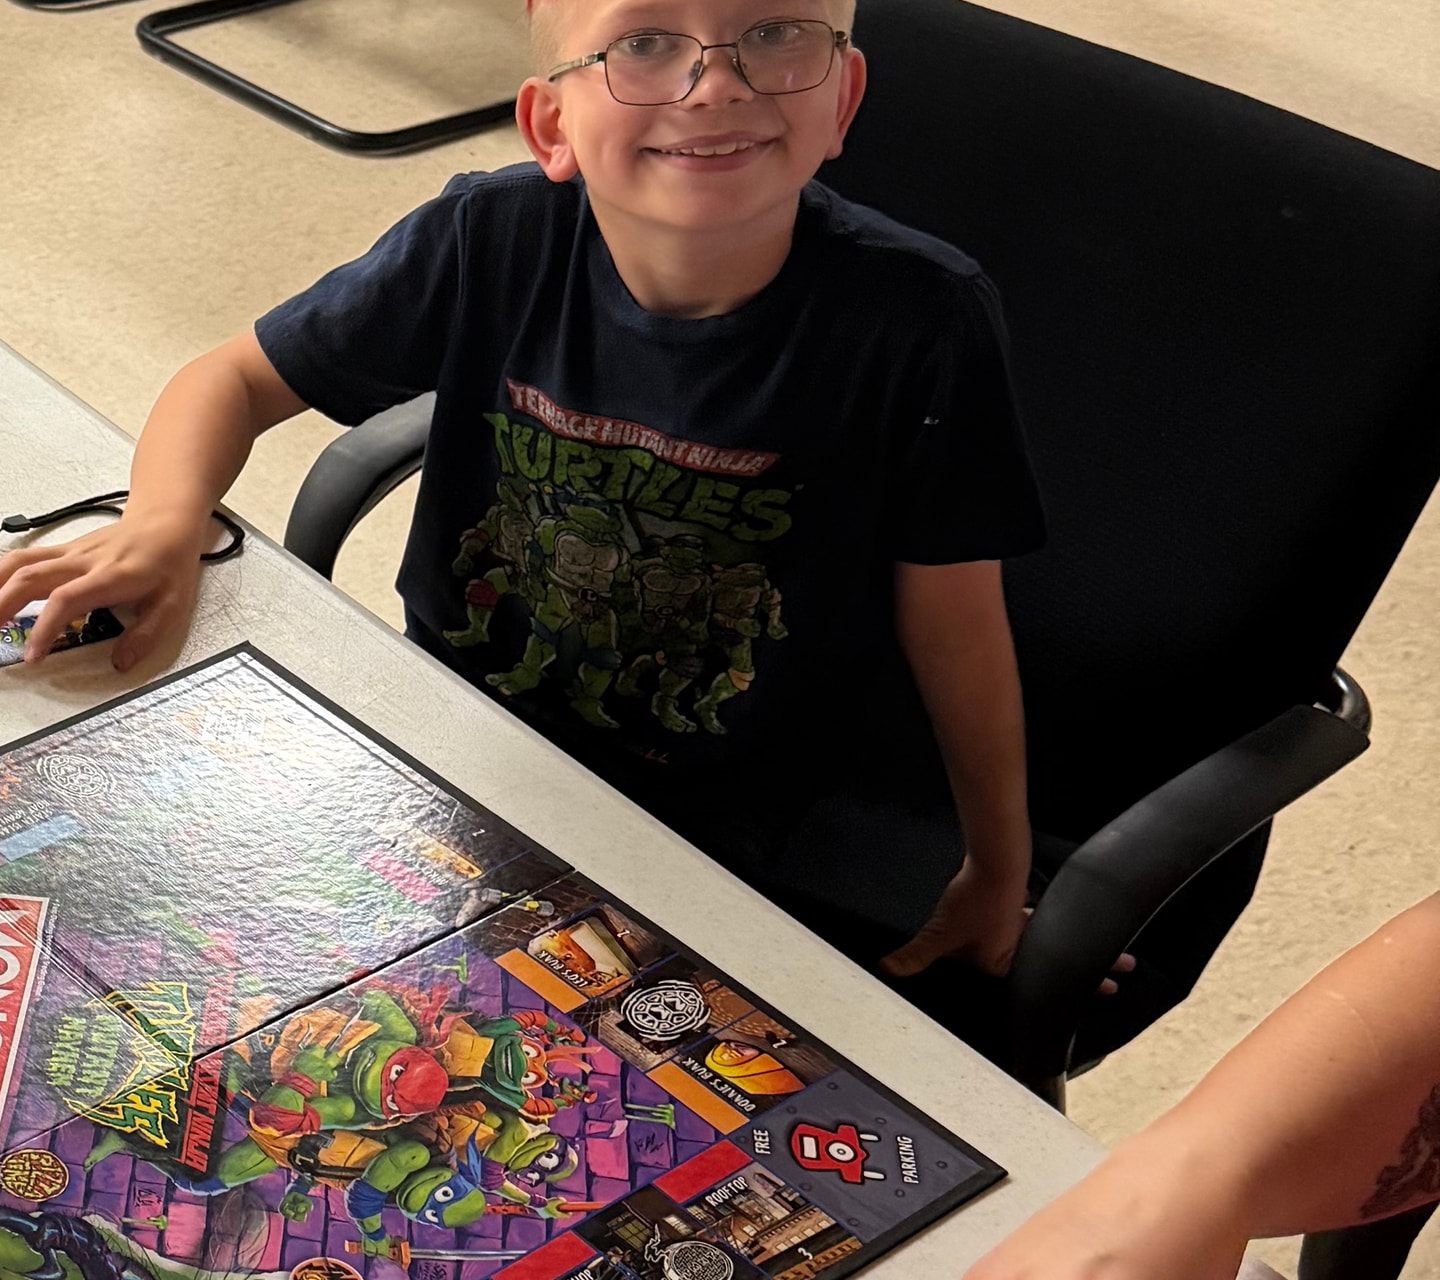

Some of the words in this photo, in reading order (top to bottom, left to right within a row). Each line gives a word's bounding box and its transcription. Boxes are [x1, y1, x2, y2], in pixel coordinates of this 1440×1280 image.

[512, 385, 598, 438] TEENAGE
[600, 421, 689, 465] MUTANT
[686, 446, 768, 475] NINJA
[483, 412, 793, 542] TURTLES
[559, 964, 590, 990] LEO'S
[180, 1113, 217, 1173] NINJA
[754, 1128, 771, 1155] FREE
[901, 1135, 918, 1185] PARKING
[704, 1173, 750, 1209] ROOFTOP
[796, 1243, 815, 1264] 3
